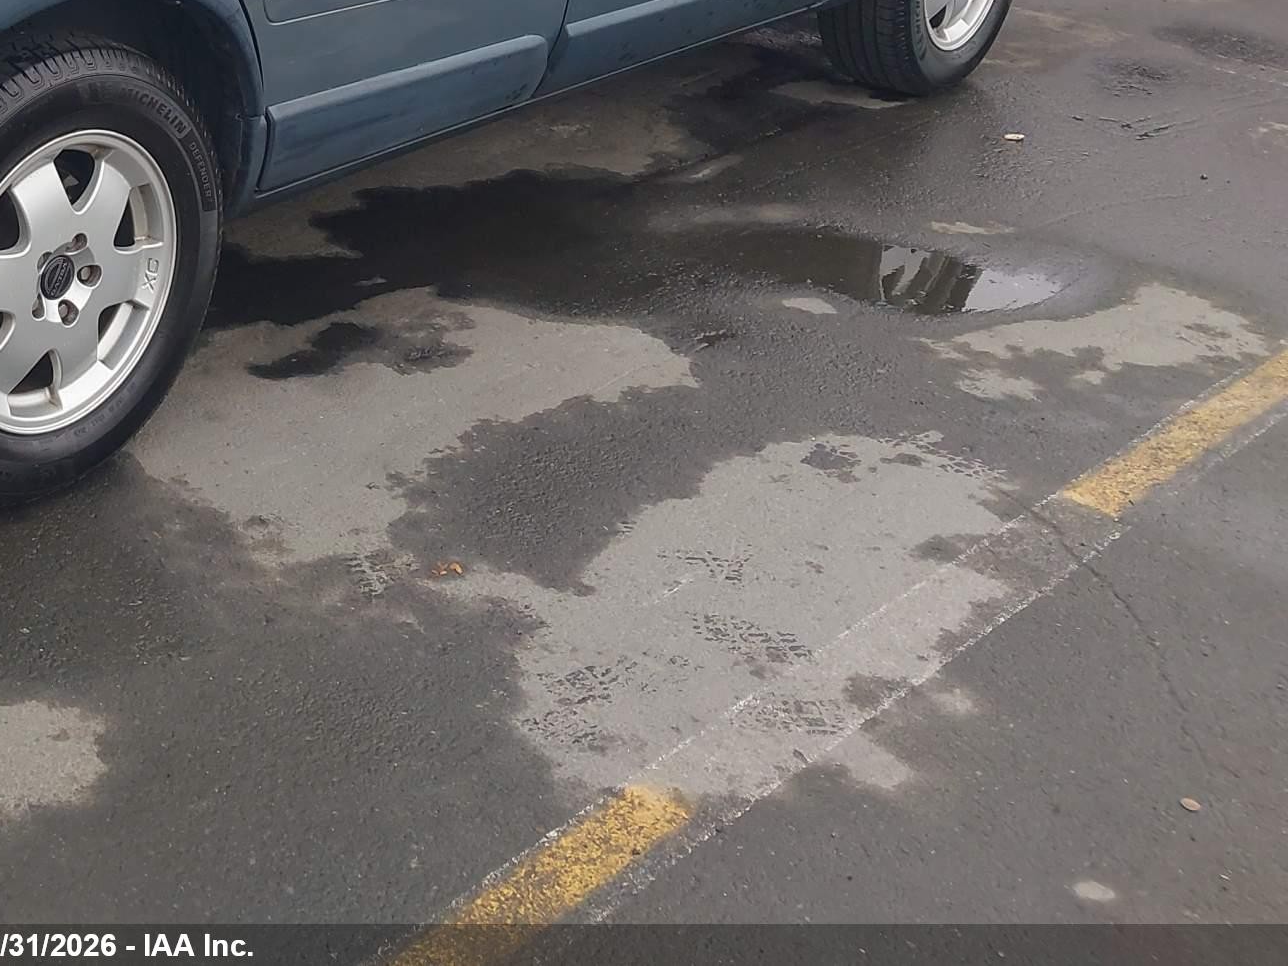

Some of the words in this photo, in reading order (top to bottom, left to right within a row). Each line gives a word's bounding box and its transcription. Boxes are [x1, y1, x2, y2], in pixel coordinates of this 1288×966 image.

[188, 140, 212, 198] DEFENDER
[50, 262, 68, 296] VOLVO
[141, 257, 160, 293] XC
